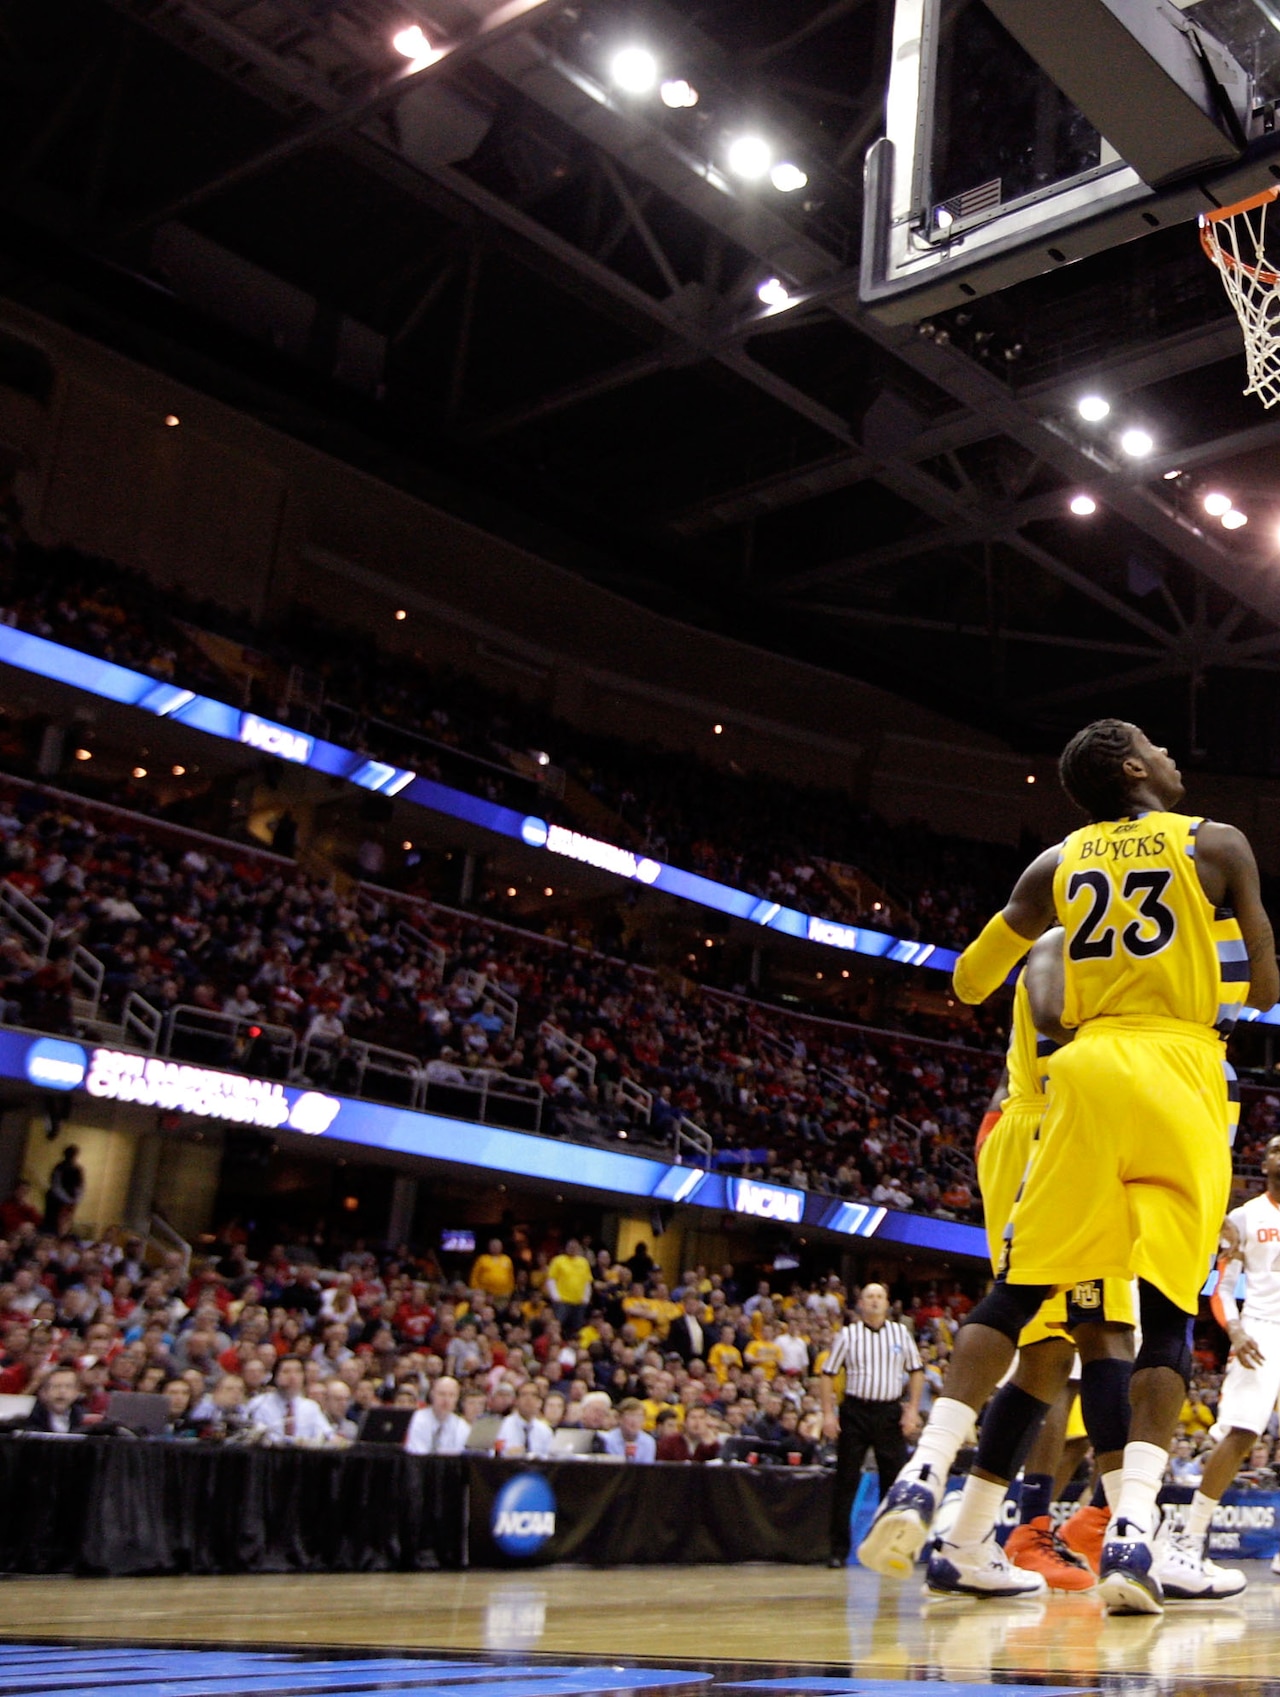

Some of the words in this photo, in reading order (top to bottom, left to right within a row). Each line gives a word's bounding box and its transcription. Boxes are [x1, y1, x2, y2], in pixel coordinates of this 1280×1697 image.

[1080, 832, 1166, 861] BUYCKS
[1067, 867, 1176, 961] 23
[736, 1180, 801, 1223] NCAA
[494, 1510, 556, 1537] NCAA
[1211, 1505, 1276, 1529] ROUNDS
